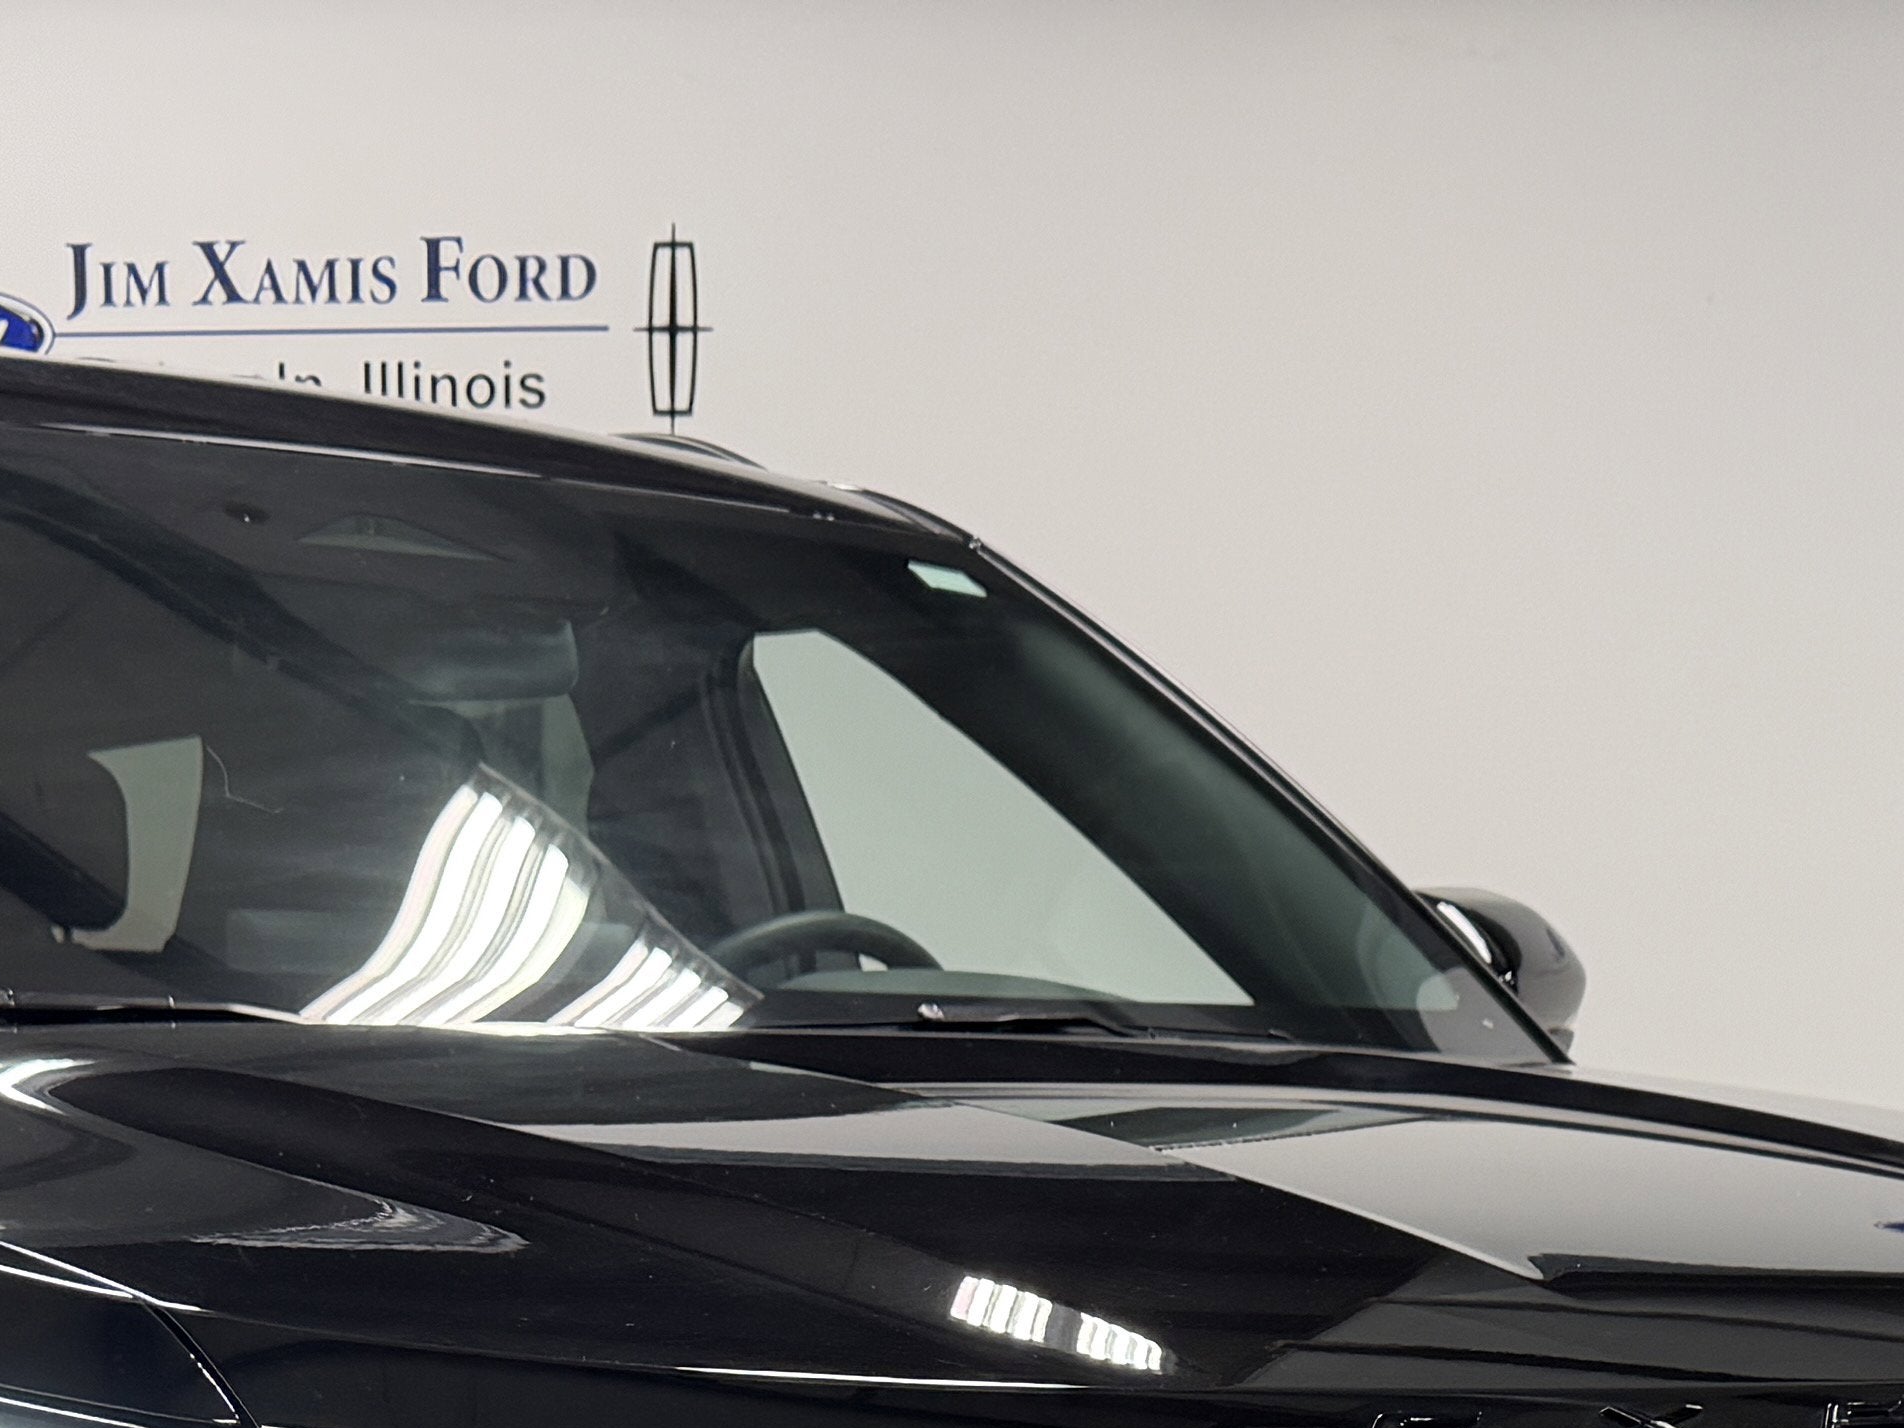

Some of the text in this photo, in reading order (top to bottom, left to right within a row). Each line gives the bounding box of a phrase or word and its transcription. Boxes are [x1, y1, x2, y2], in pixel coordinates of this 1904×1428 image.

[66, 236, 597, 320] JIM XAMIS FORD
[363, 360, 546, 409] Illinois
